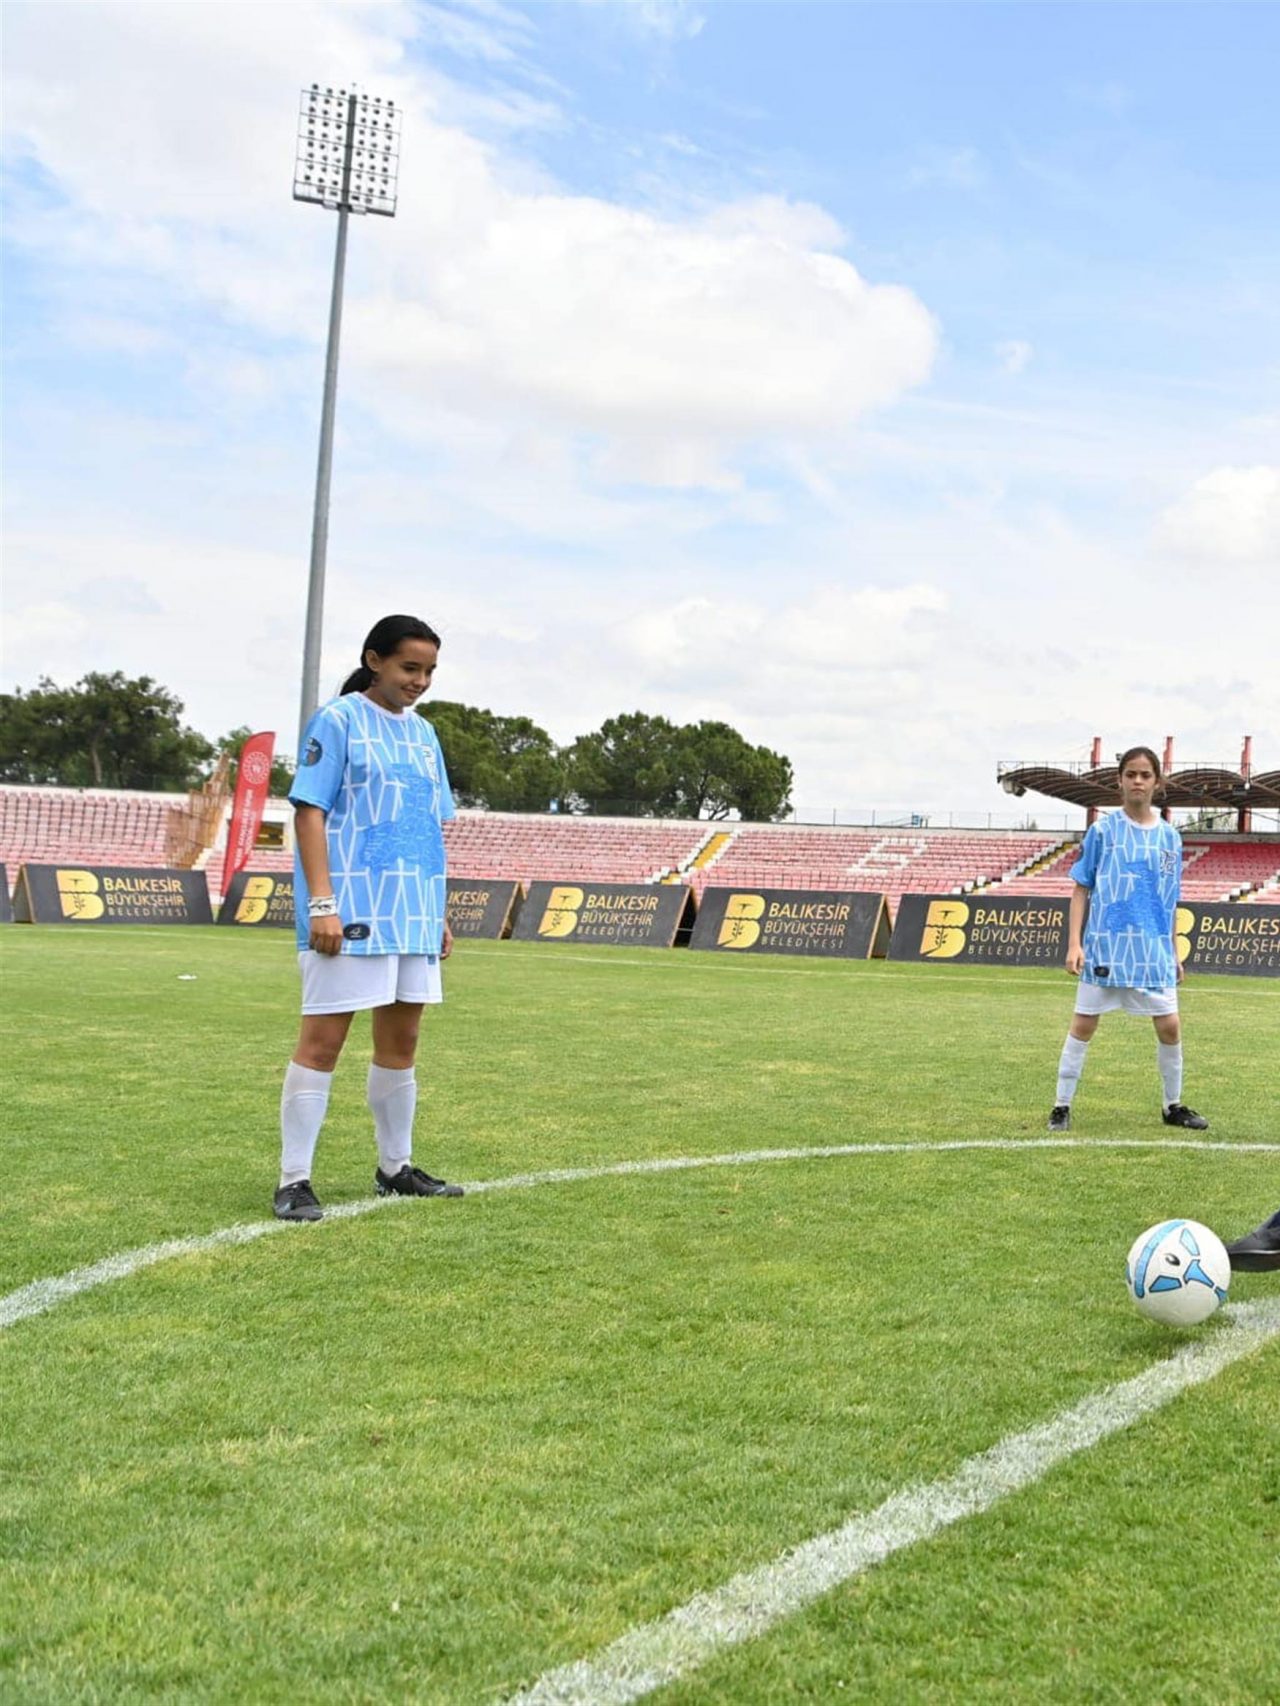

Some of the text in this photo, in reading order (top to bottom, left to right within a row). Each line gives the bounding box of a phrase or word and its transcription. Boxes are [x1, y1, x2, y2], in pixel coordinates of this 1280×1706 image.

[103, 876, 183, 892] BALIKESİR
[448, 890, 490, 906] IKESİR
[586, 894, 659, 910] BALIKESİR
[768, 902, 850, 920] BALIKESİR
[974, 908, 1063, 927] BALIKESİR
[971, 926, 1060, 945] BÜYÜKŞEHİR
